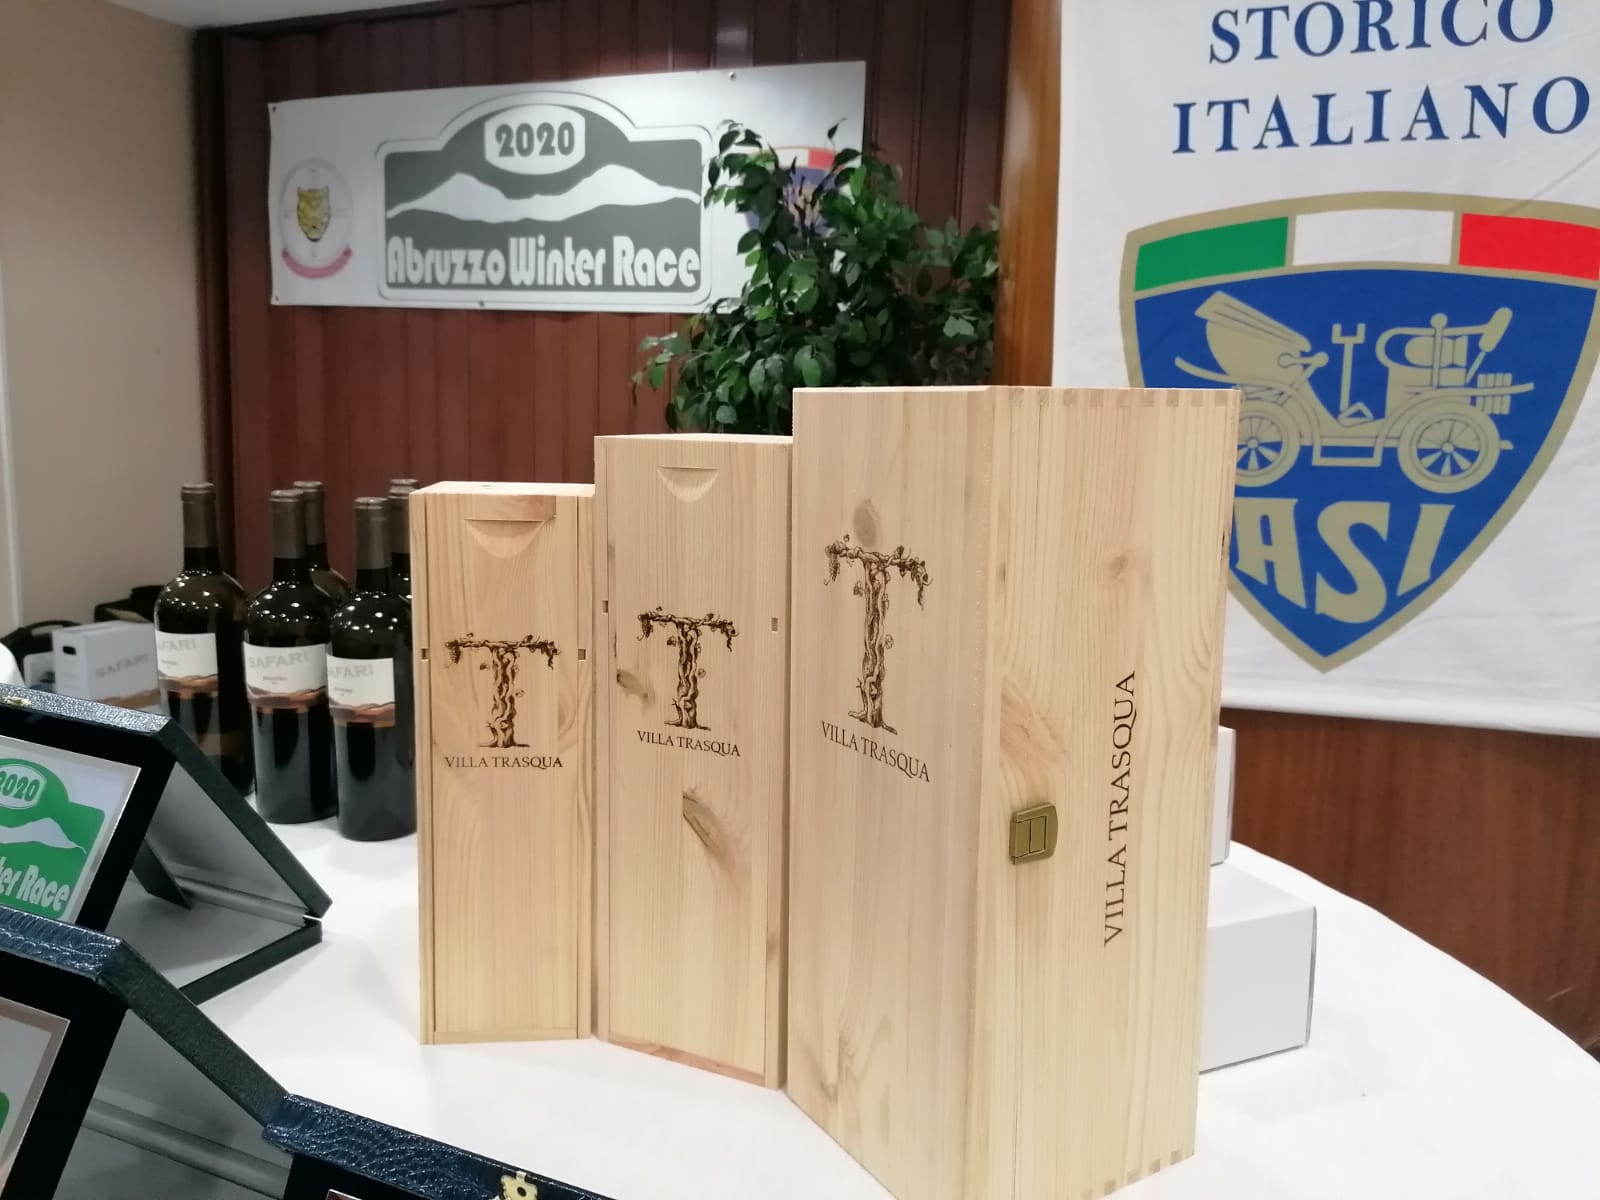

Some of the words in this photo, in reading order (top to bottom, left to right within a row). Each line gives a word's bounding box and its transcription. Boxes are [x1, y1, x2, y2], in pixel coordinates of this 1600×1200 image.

[1208, 0, 1554, 65] STORICO
[495, 120, 576, 158] 2020
[1171, 75, 1590, 155] ITALIANO
[386, 235, 507, 285] Abruzzo
[508, 233, 606, 287] Winter
[612, 235, 701, 288] Race
[1234, 496, 1456, 625] ASI
[248, 650, 310, 669] SAFARI
[445, 756, 489, 768] VILLA
[491, 756, 563, 770] TRASQUA
[637, 730, 674, 747] VILLA
[676, 736, 741, 757] TRASQUA
[820, 720, 860, 752] VILLA
[861, 736, 931, 783] TRASQUA
[1108, 670, 1138, 841] TRASQUA
[15, 864, 71, 912] Race
[1103, 844, 1127, 948] VILLA
